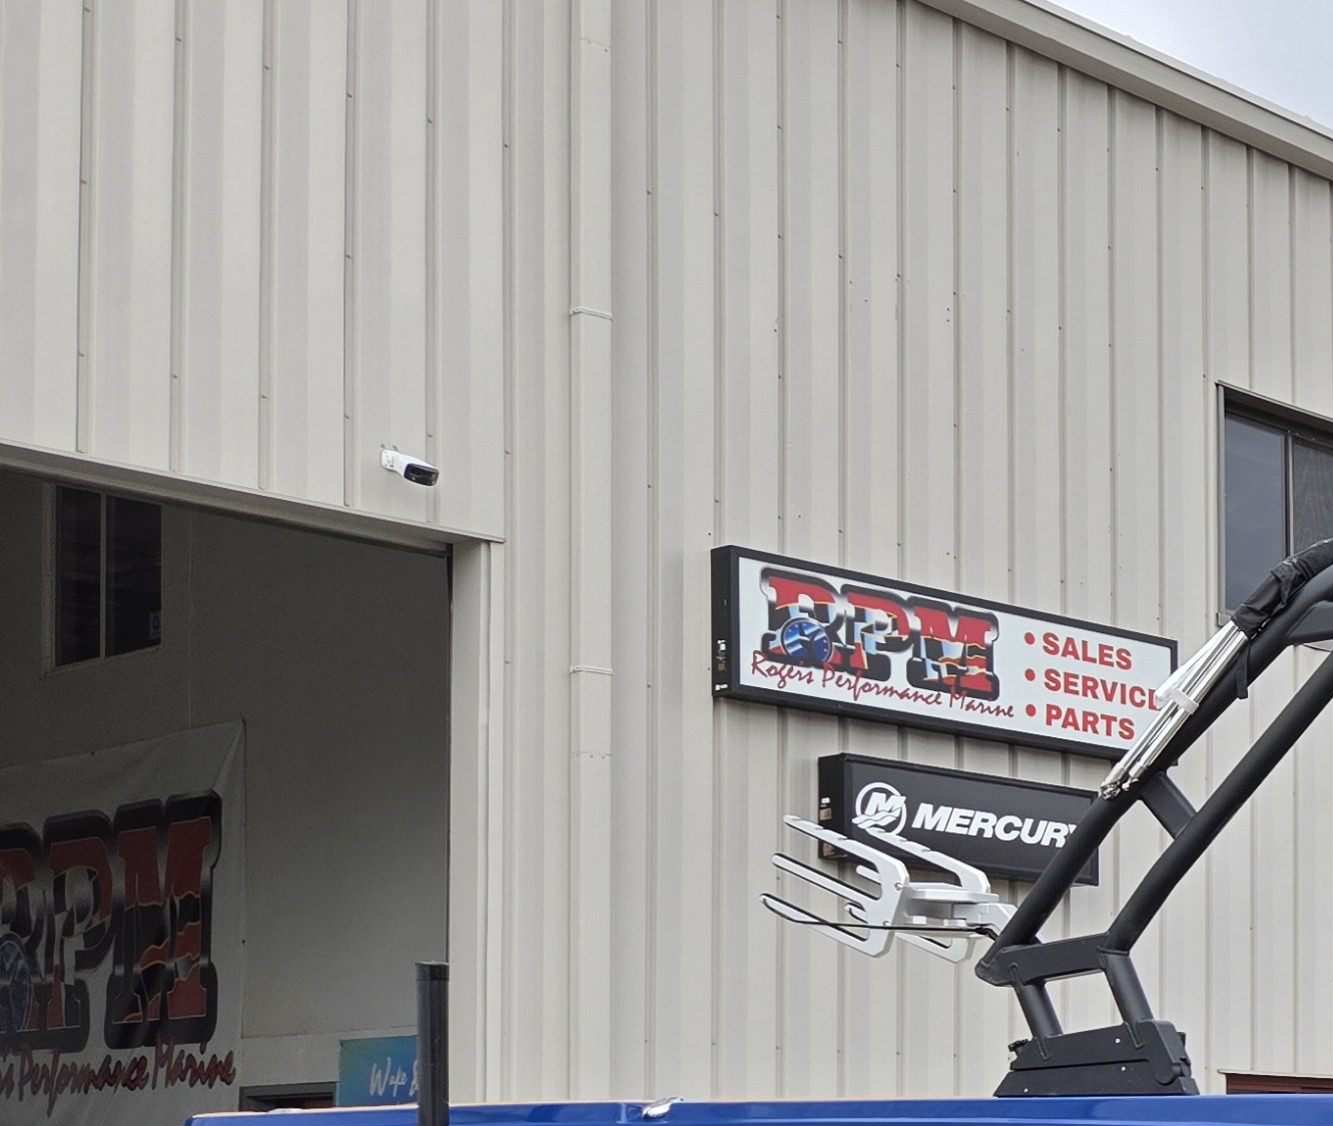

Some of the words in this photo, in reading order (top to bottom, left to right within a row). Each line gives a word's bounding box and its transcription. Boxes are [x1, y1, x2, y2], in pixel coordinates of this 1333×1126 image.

[759, 566, 1000, 701] RPM
[1042, 632, 1132, 670] SALES
[752, 650, 815, 688] Rogers
[822, 661, 942, 701] Performance
[949, 687, 1015, 718] Marine
[1045, 703, 1135, 740] PARTS
[912, 802, 1077, 848] MERCUR
[18, 1043, 150, 1118] Performance
[151, 1032, 236, 1090] Marine
